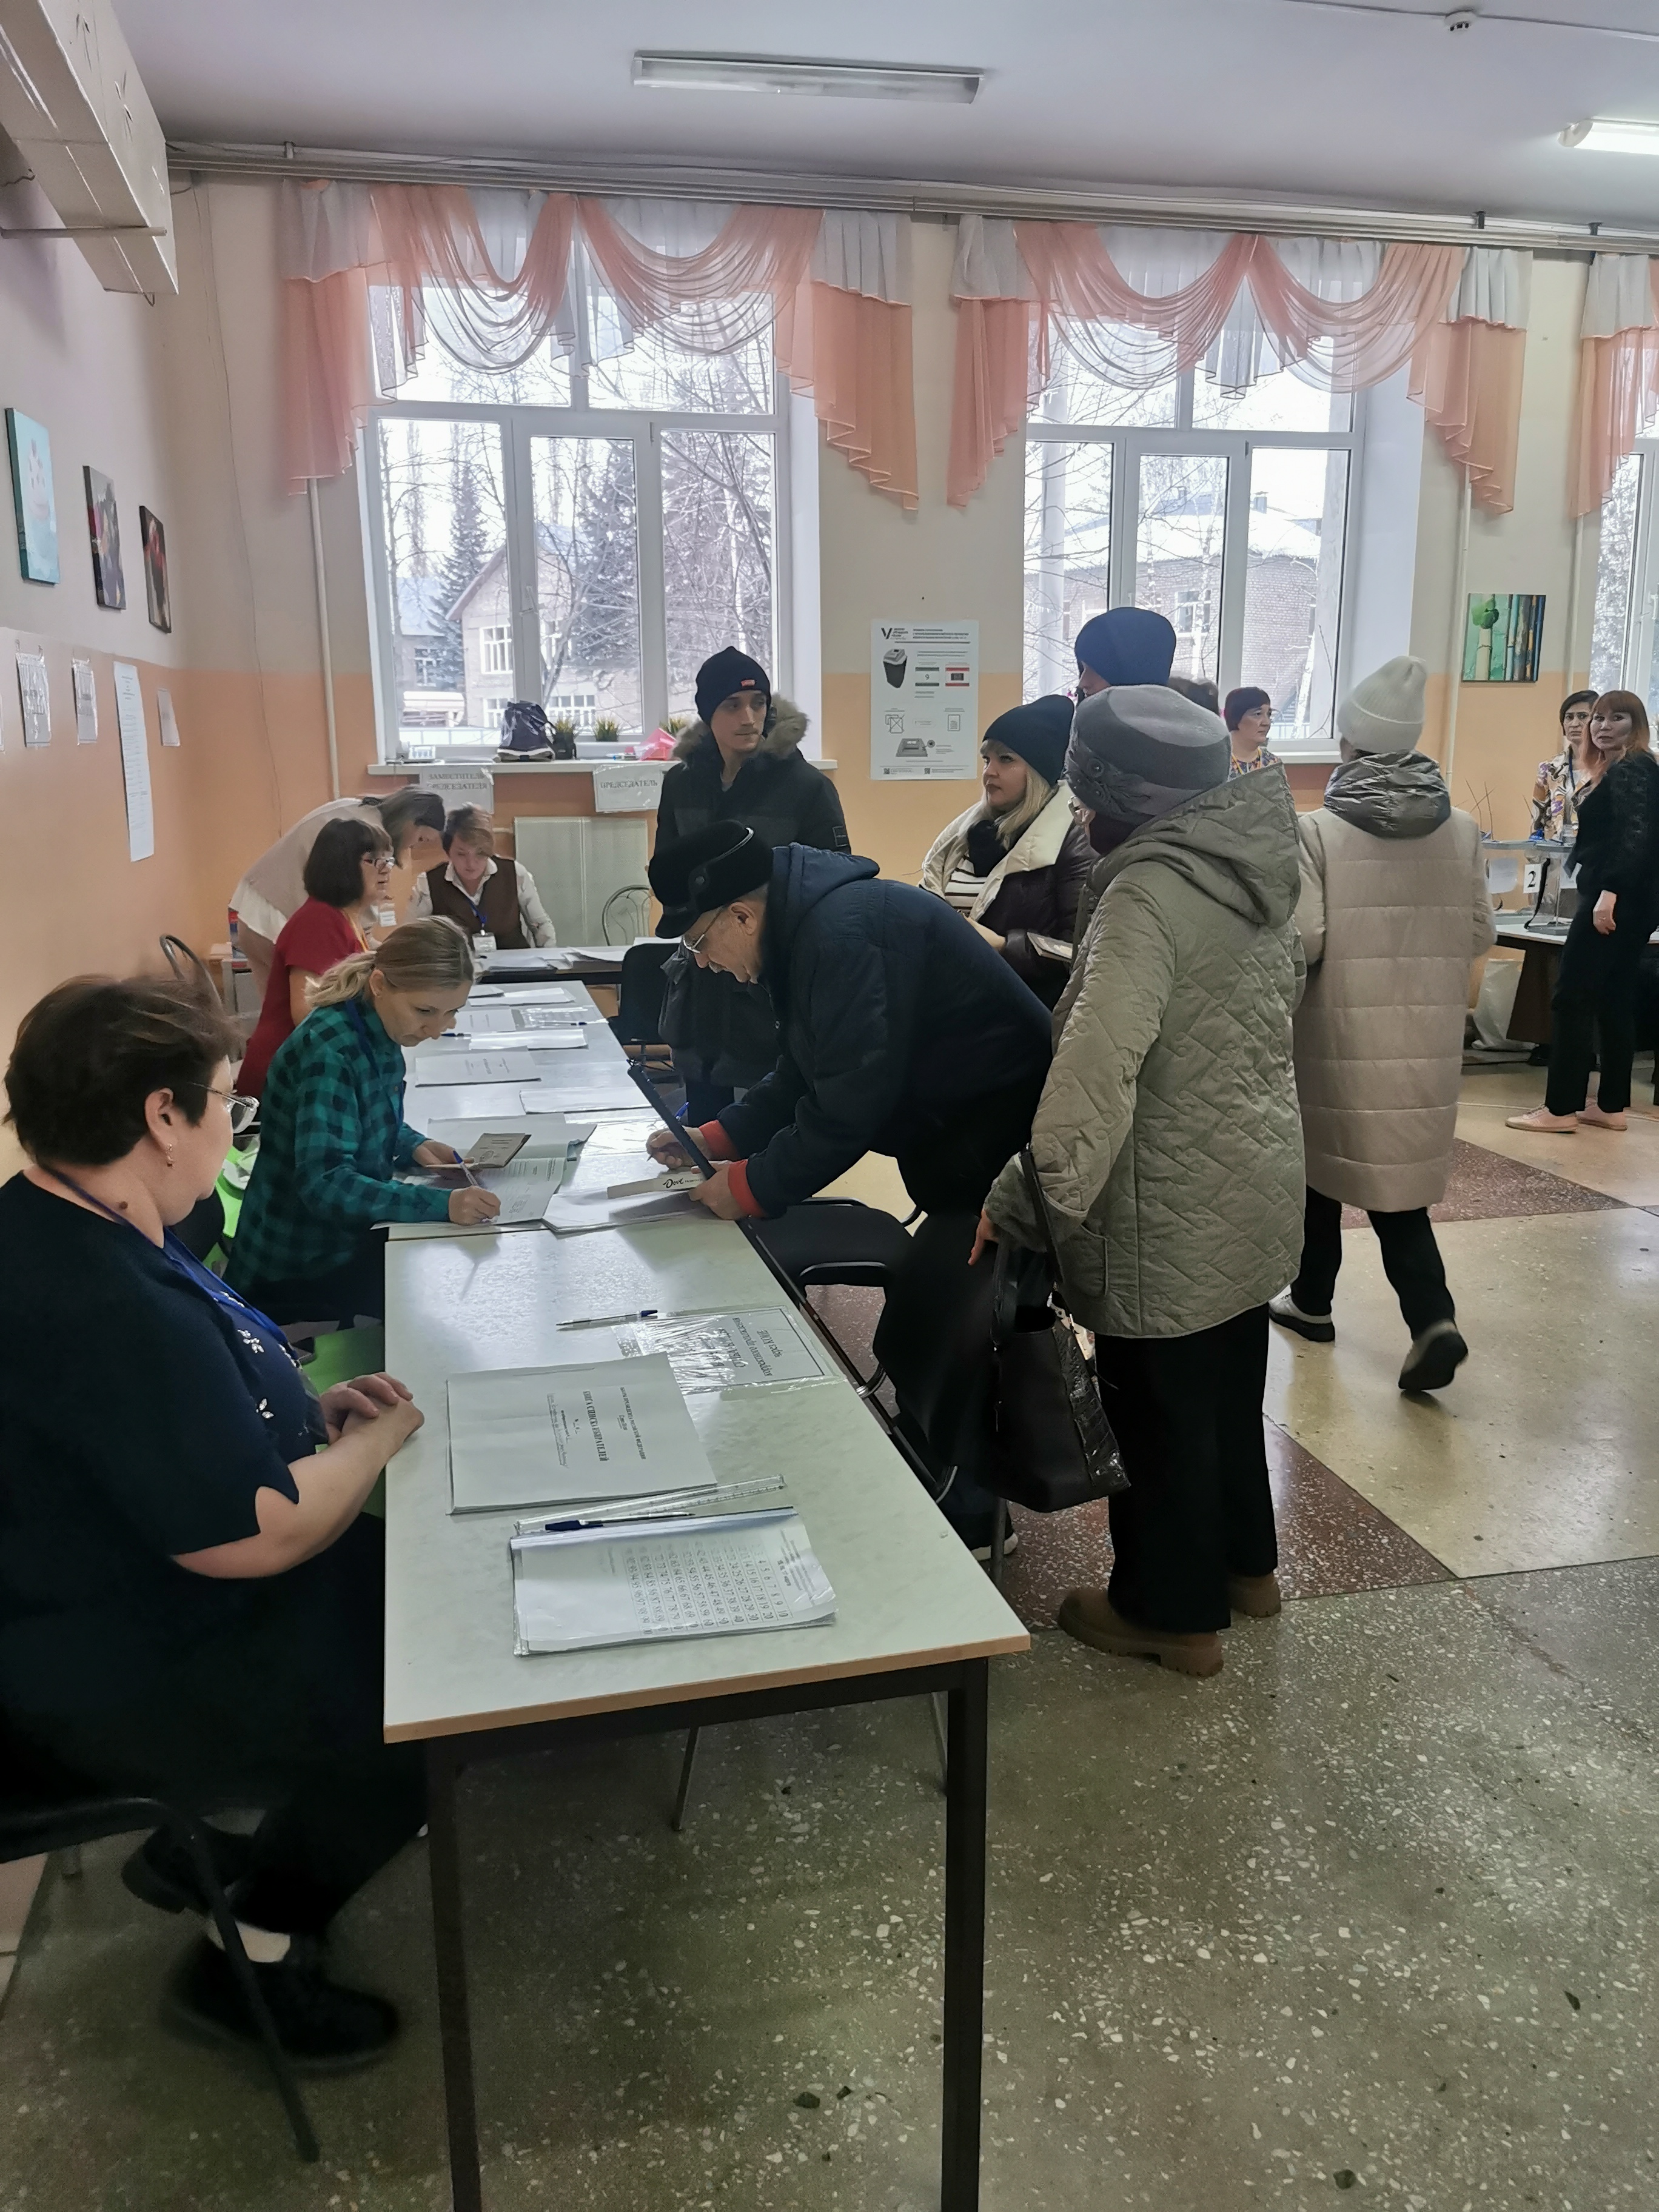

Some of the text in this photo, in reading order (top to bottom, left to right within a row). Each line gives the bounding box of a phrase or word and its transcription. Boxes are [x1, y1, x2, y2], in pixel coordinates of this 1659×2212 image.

[600, 780, 658, 788] ПРЕДСЕДАТЕЛЬ
[1527, 871, 1537, 888] 2
[663, 1178, 684, 1188] Dove
[768, 1344, 783, 1358] через
[749, 1347, 773, 1376] корректного
[592, 1427, 609, 1461] ИЗБИРАТЕЛЕЙ
